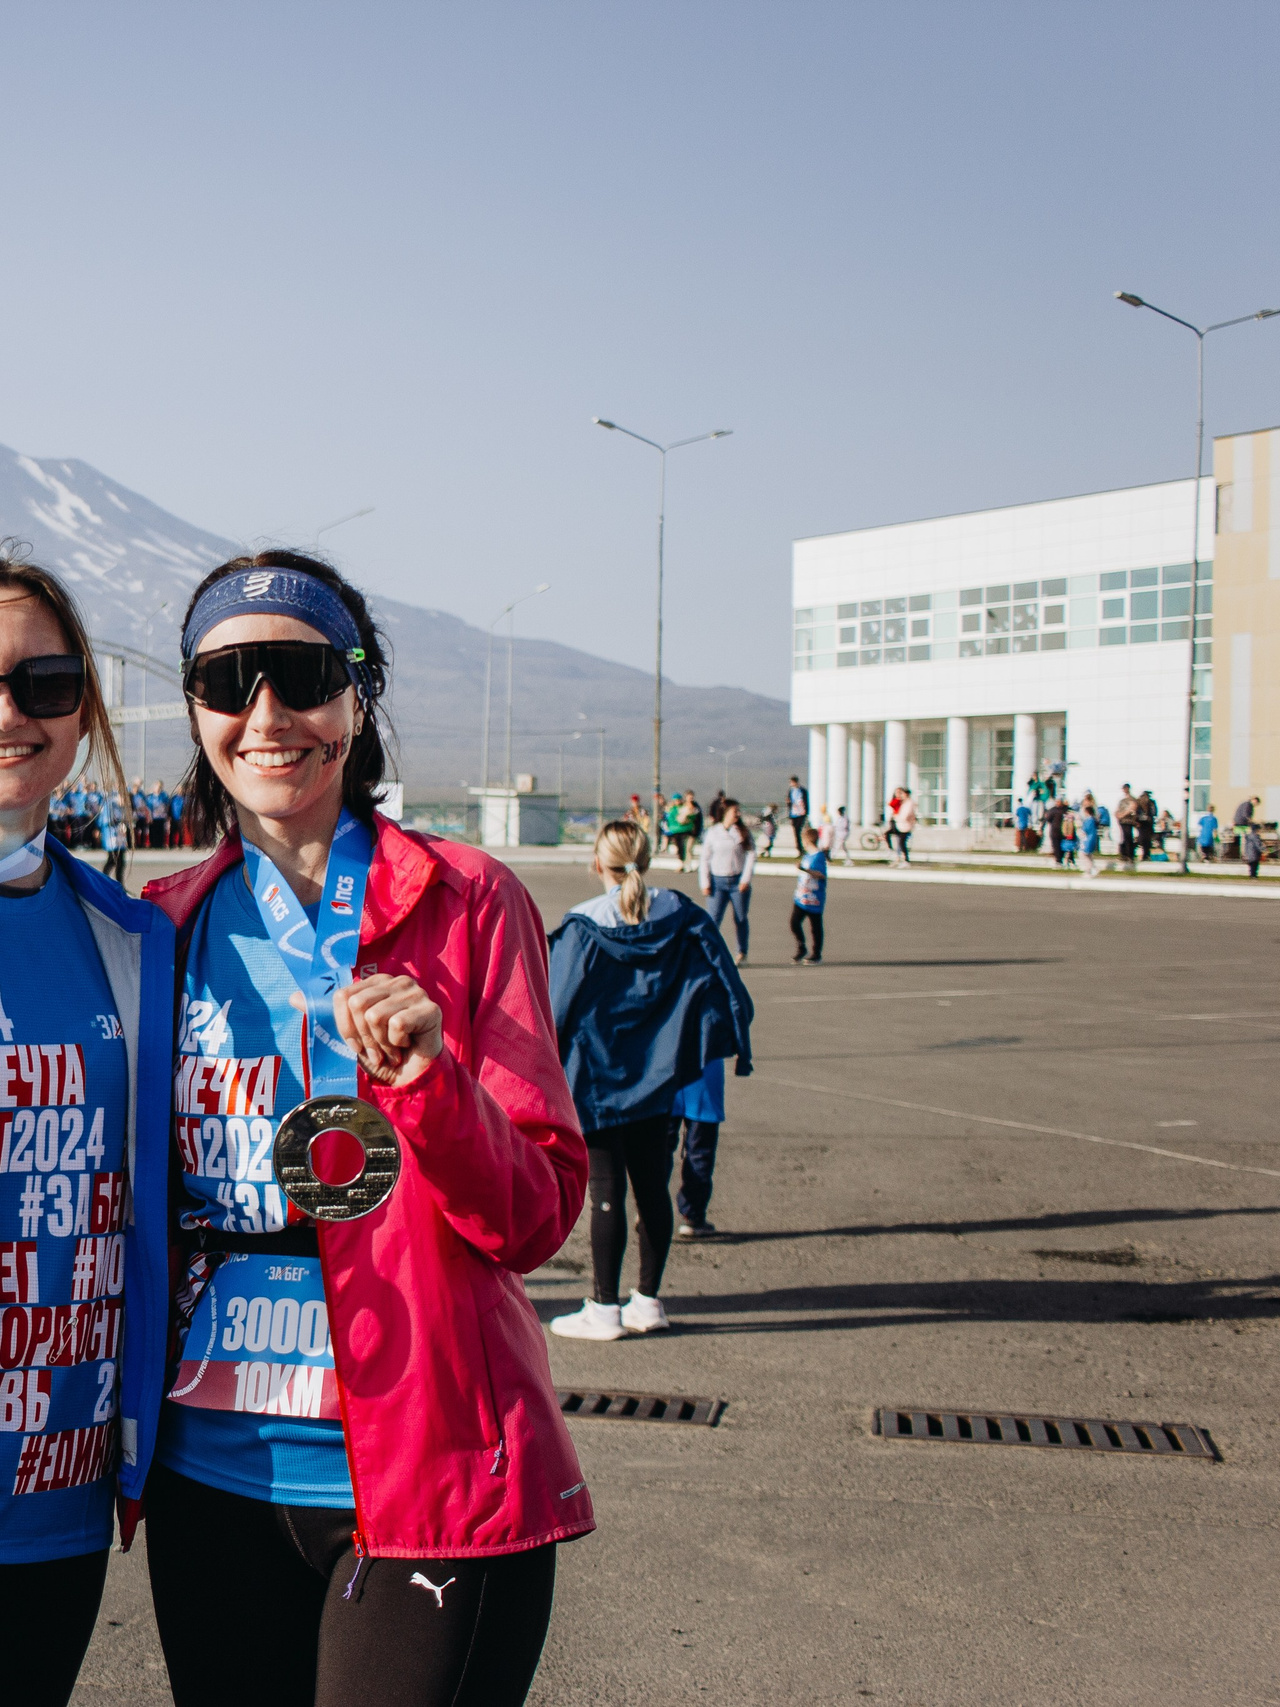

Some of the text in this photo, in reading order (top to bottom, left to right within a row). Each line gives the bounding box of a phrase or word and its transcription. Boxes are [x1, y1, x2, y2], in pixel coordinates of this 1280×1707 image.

[269, 892, 290, 922] ПСБ
[335, 875, 354, 901] ПСБ
[222, 1296, 335, 1358] 3000
[234, 1361, 325, 1419] 10КМ
